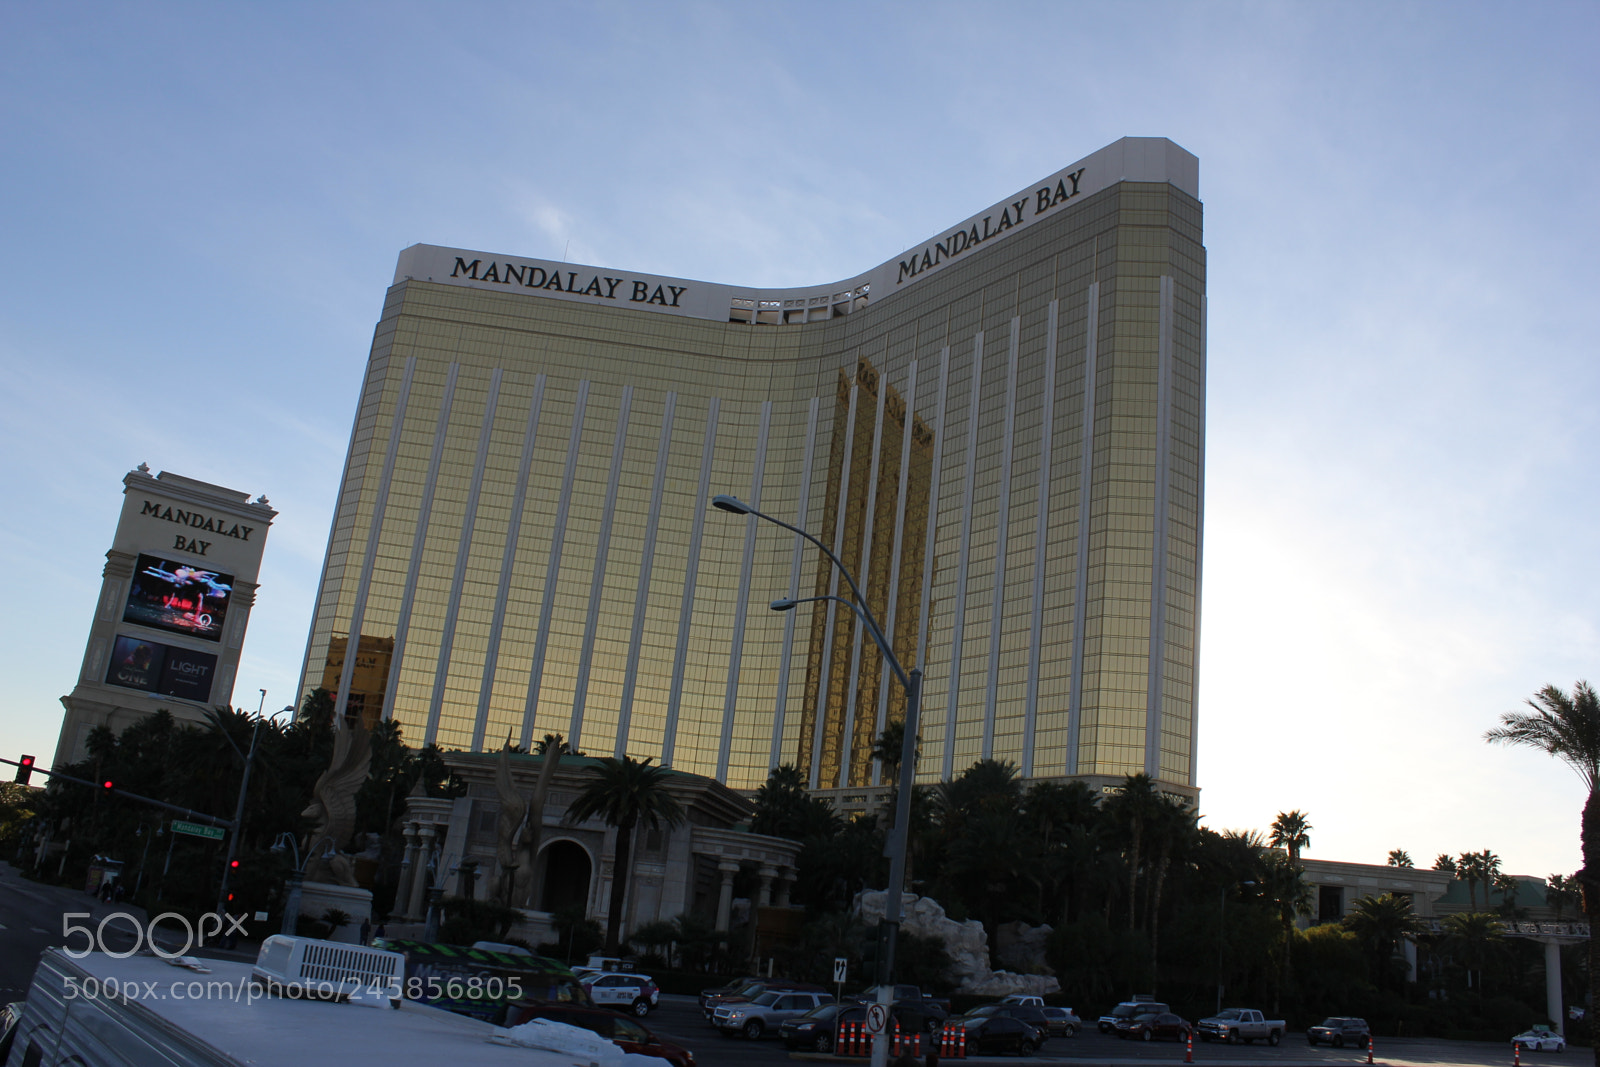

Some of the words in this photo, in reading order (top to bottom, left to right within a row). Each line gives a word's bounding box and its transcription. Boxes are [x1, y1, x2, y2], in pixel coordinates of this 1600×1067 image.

[896, 197, 1029, 284] MANDALAY
[1034, 167, 1086, 216] BAY
[450, 257, 624, 299] MANDALAY
[629, 280, 688, 307] BAY
[140, 500, 254, 541] MANDALAY
[173, 534, 212, 556] BAY
[170, 659, 208, 676] LIGHT
